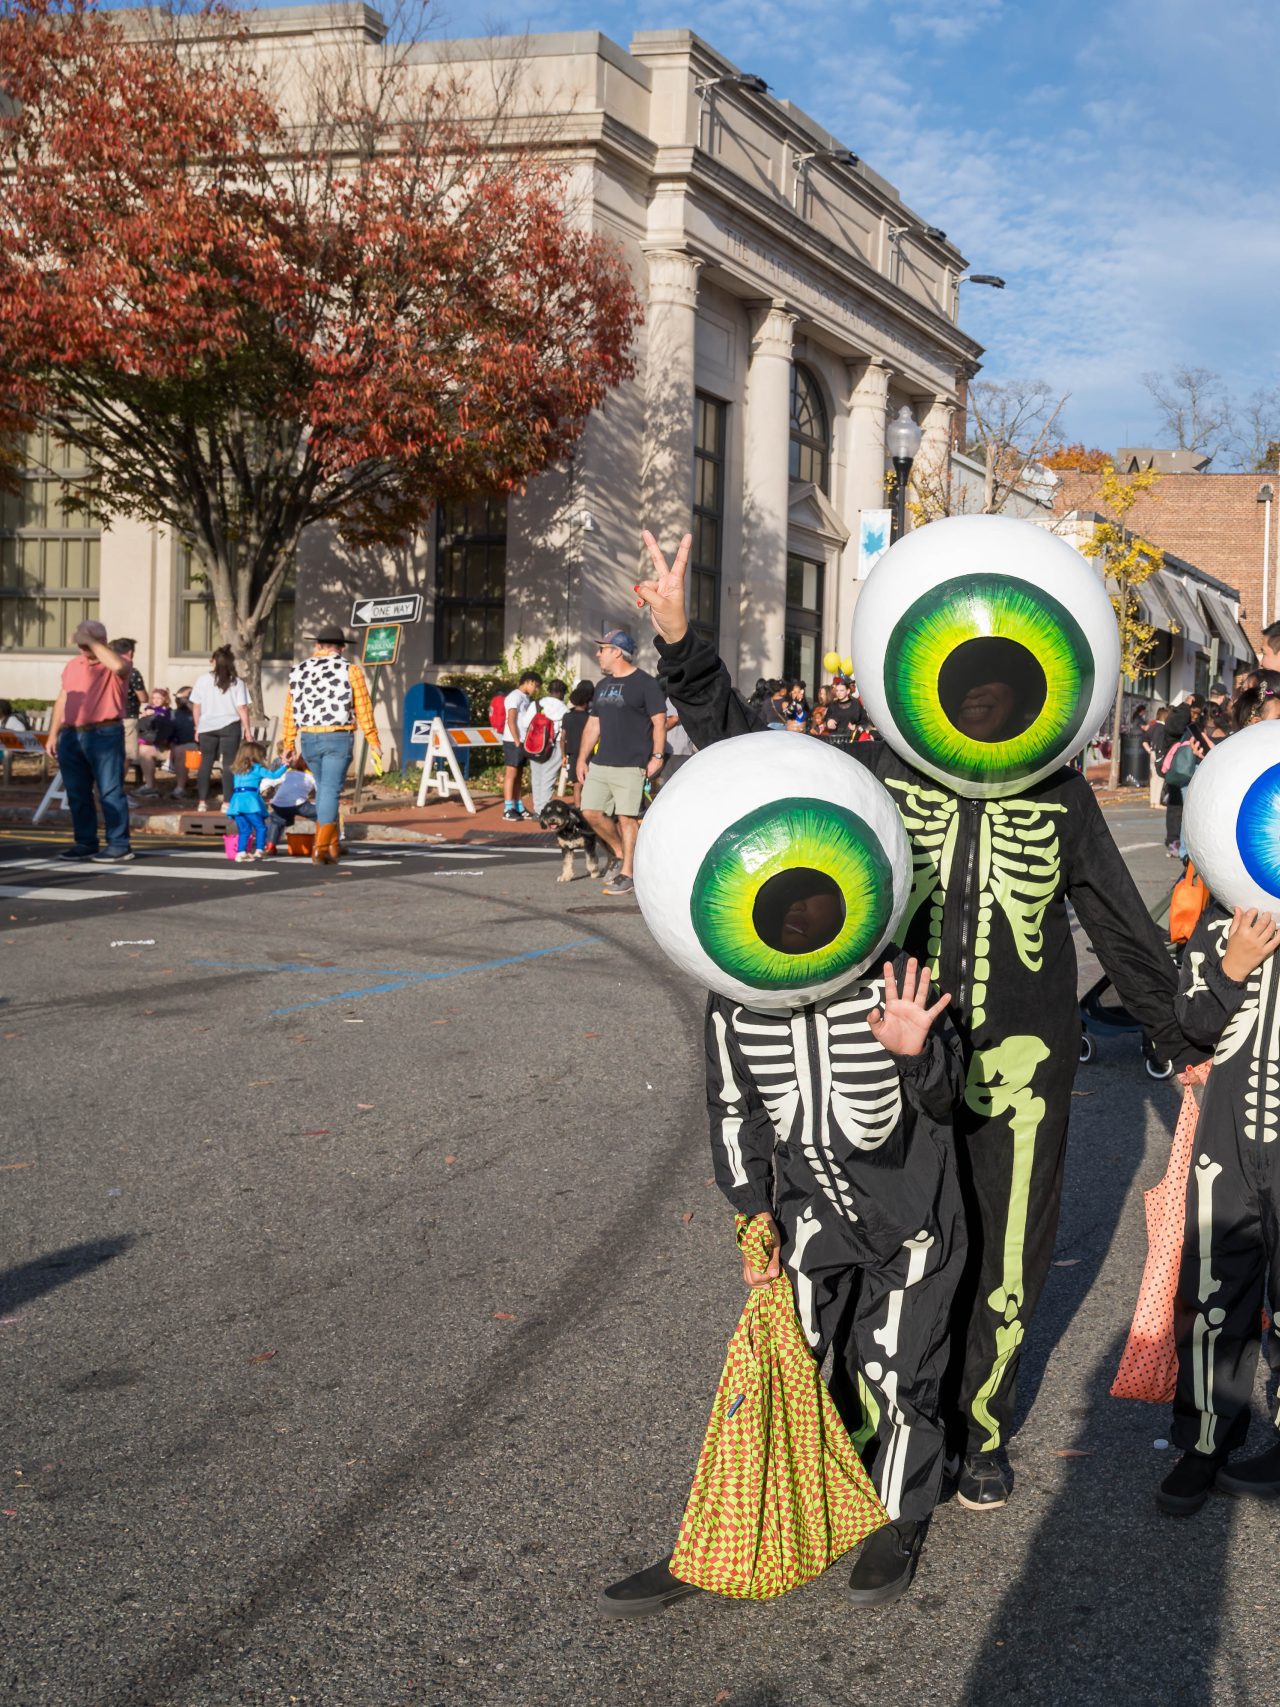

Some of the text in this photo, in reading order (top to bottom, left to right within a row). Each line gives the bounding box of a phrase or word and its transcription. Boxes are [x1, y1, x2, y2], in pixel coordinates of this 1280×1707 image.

[724, 227, 749, 262] THE
[372, 603, 411, 617] ONE WAY
